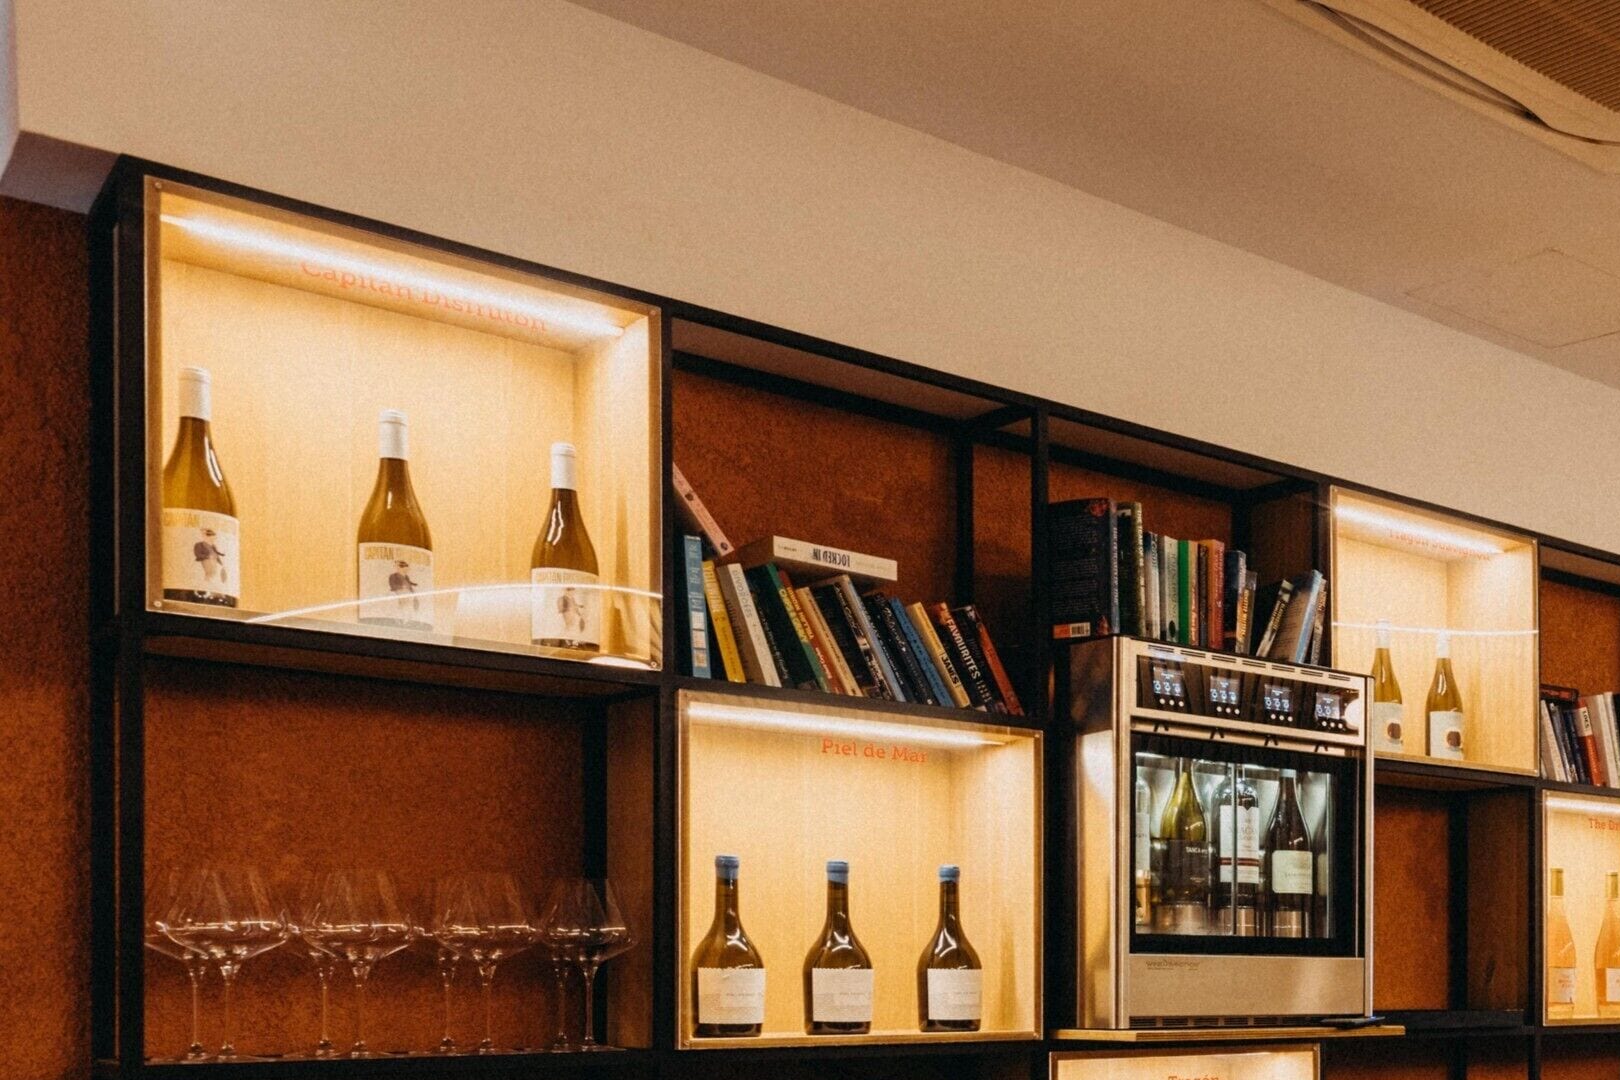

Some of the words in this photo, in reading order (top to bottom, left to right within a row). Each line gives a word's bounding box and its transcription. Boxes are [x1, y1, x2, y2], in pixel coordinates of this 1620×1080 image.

[944, 619, 981, 681] FAVOURITES
[864, 745, 887, 759] de
[892, 746, 928, 763] Mar
[1589, 817, 1605, 830] The
